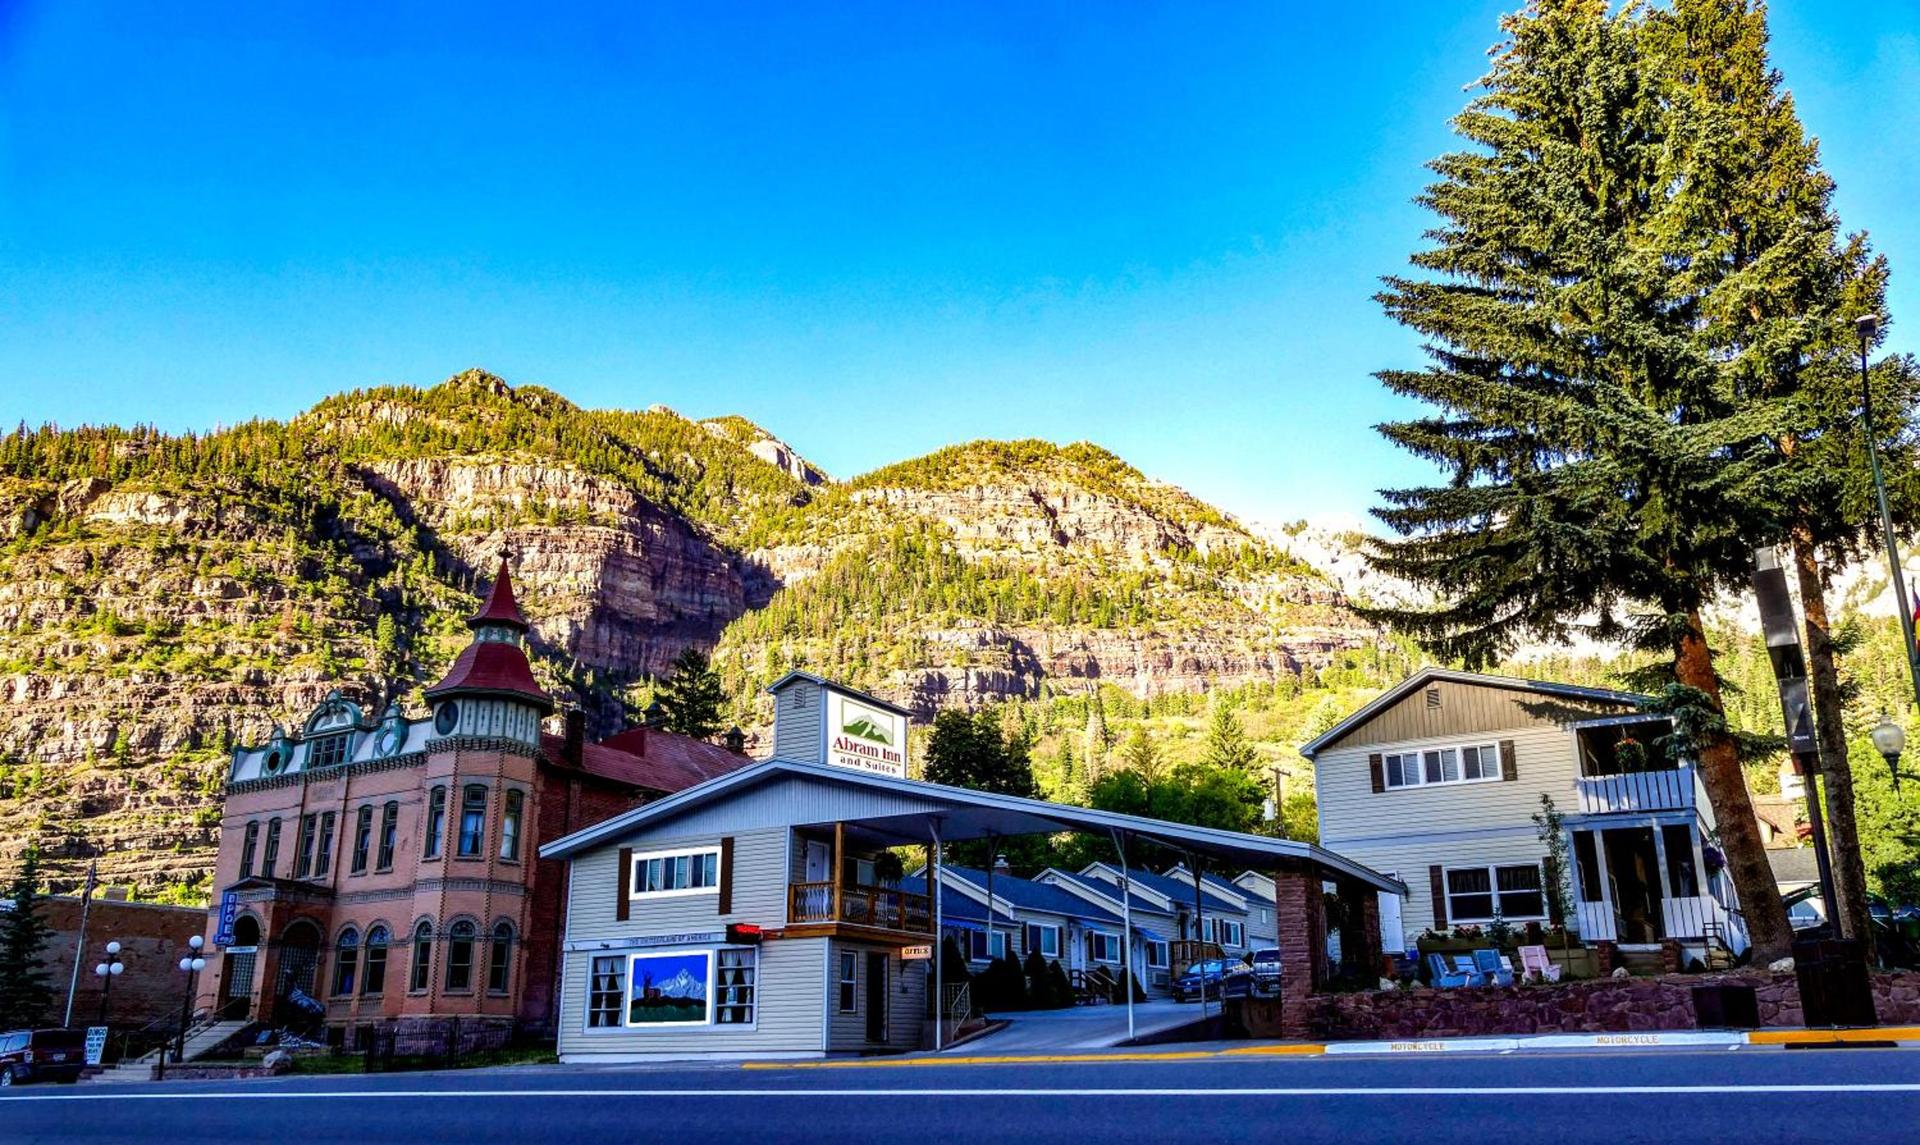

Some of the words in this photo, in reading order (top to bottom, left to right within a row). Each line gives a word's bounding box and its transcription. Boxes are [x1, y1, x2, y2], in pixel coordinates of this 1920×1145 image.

[833, 736, 879, 758] Abram
[882, 747, 901, 762] Inn
[840, 755, 861, 767] and
[865, 760, 897, 773] Suites
[1391, 1043, 1445, 1051] MOTORCYCLE
[1597, 1035, 1660, 1045] MOTORCYCLE
